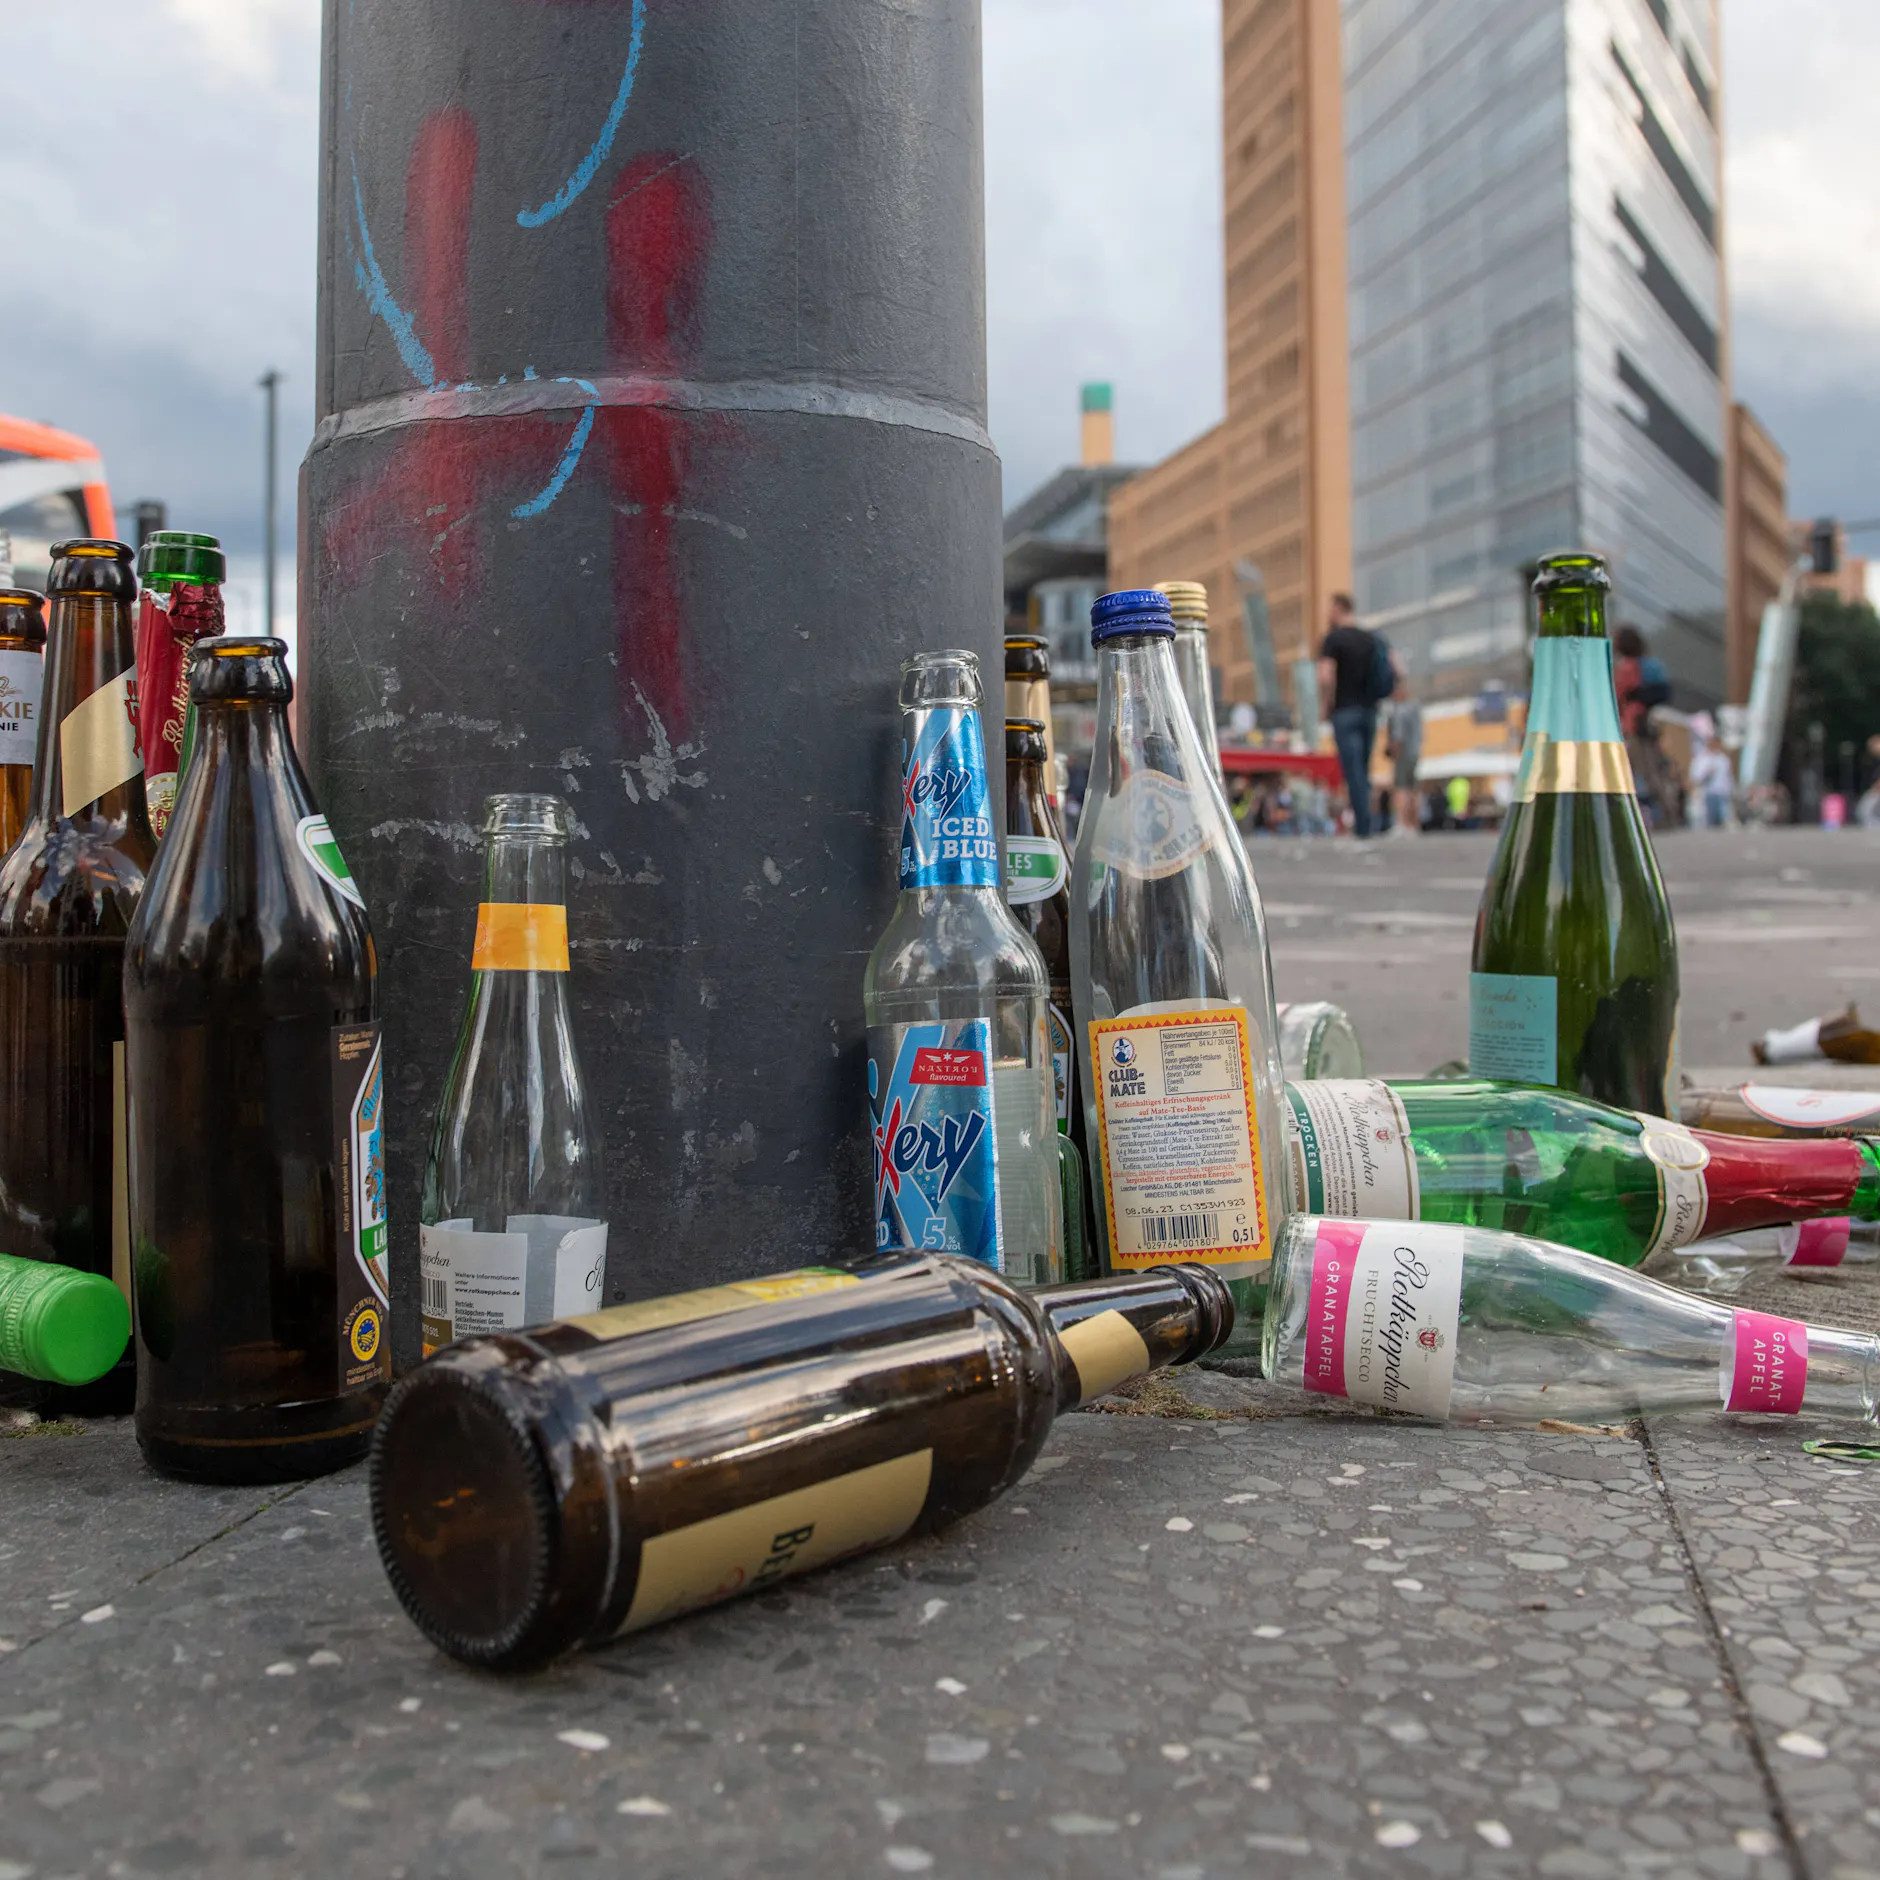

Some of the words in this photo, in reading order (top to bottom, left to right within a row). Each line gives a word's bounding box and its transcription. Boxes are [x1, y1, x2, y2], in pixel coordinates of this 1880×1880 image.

[932, 817, 989, 838] ICED
[942, 839, 997, 860] BLUE
[1007, 854, 1032, 869] LES
[930, 1073, 967, 1081] flavoured
[1108, 1068, 1144, 1083] CLUB-
[1110, 1082, 1146, 1098] MATE
[1114, 1100, 1161, 1109] Koffeinhaltiges
[1163, 1093, 1231, 1104] Erfrischungsgetränk
[1138, 1108, 1149, 1116] auf
[1150, 1105, 1206, 1115] Mate-Tee-Basis
[1298, 1112, 1317, 1167] TROCKEN
[1342, 1126, 1351, 1150] Moment
[1201, 1156, 1236, 1165] Kohlensäure
[1346, 1151, 1356, 1190] gemeinsam
[1166, 1173, 1207, 1181] erneuerbaren
[1208, 1170, 1235, 1180] Energien
[1125, 1205, 1174, 1215] 08.06.23
[920, 1217, 947, 1250] 5
[455, 1287, 520, 1296] www.rotkaeppchen.de
[1318, 1261, 1340, 1377] GRANATAPFEL
[1359, 1269, 1379, 1383] FRUCHTSECCO
[1380, 1247, 1430, 1402] Rotkäppchen
[1750, 1340, 1765, 1393] APFEL
[1770, 1332, 1786, 1406] GRANAT-
